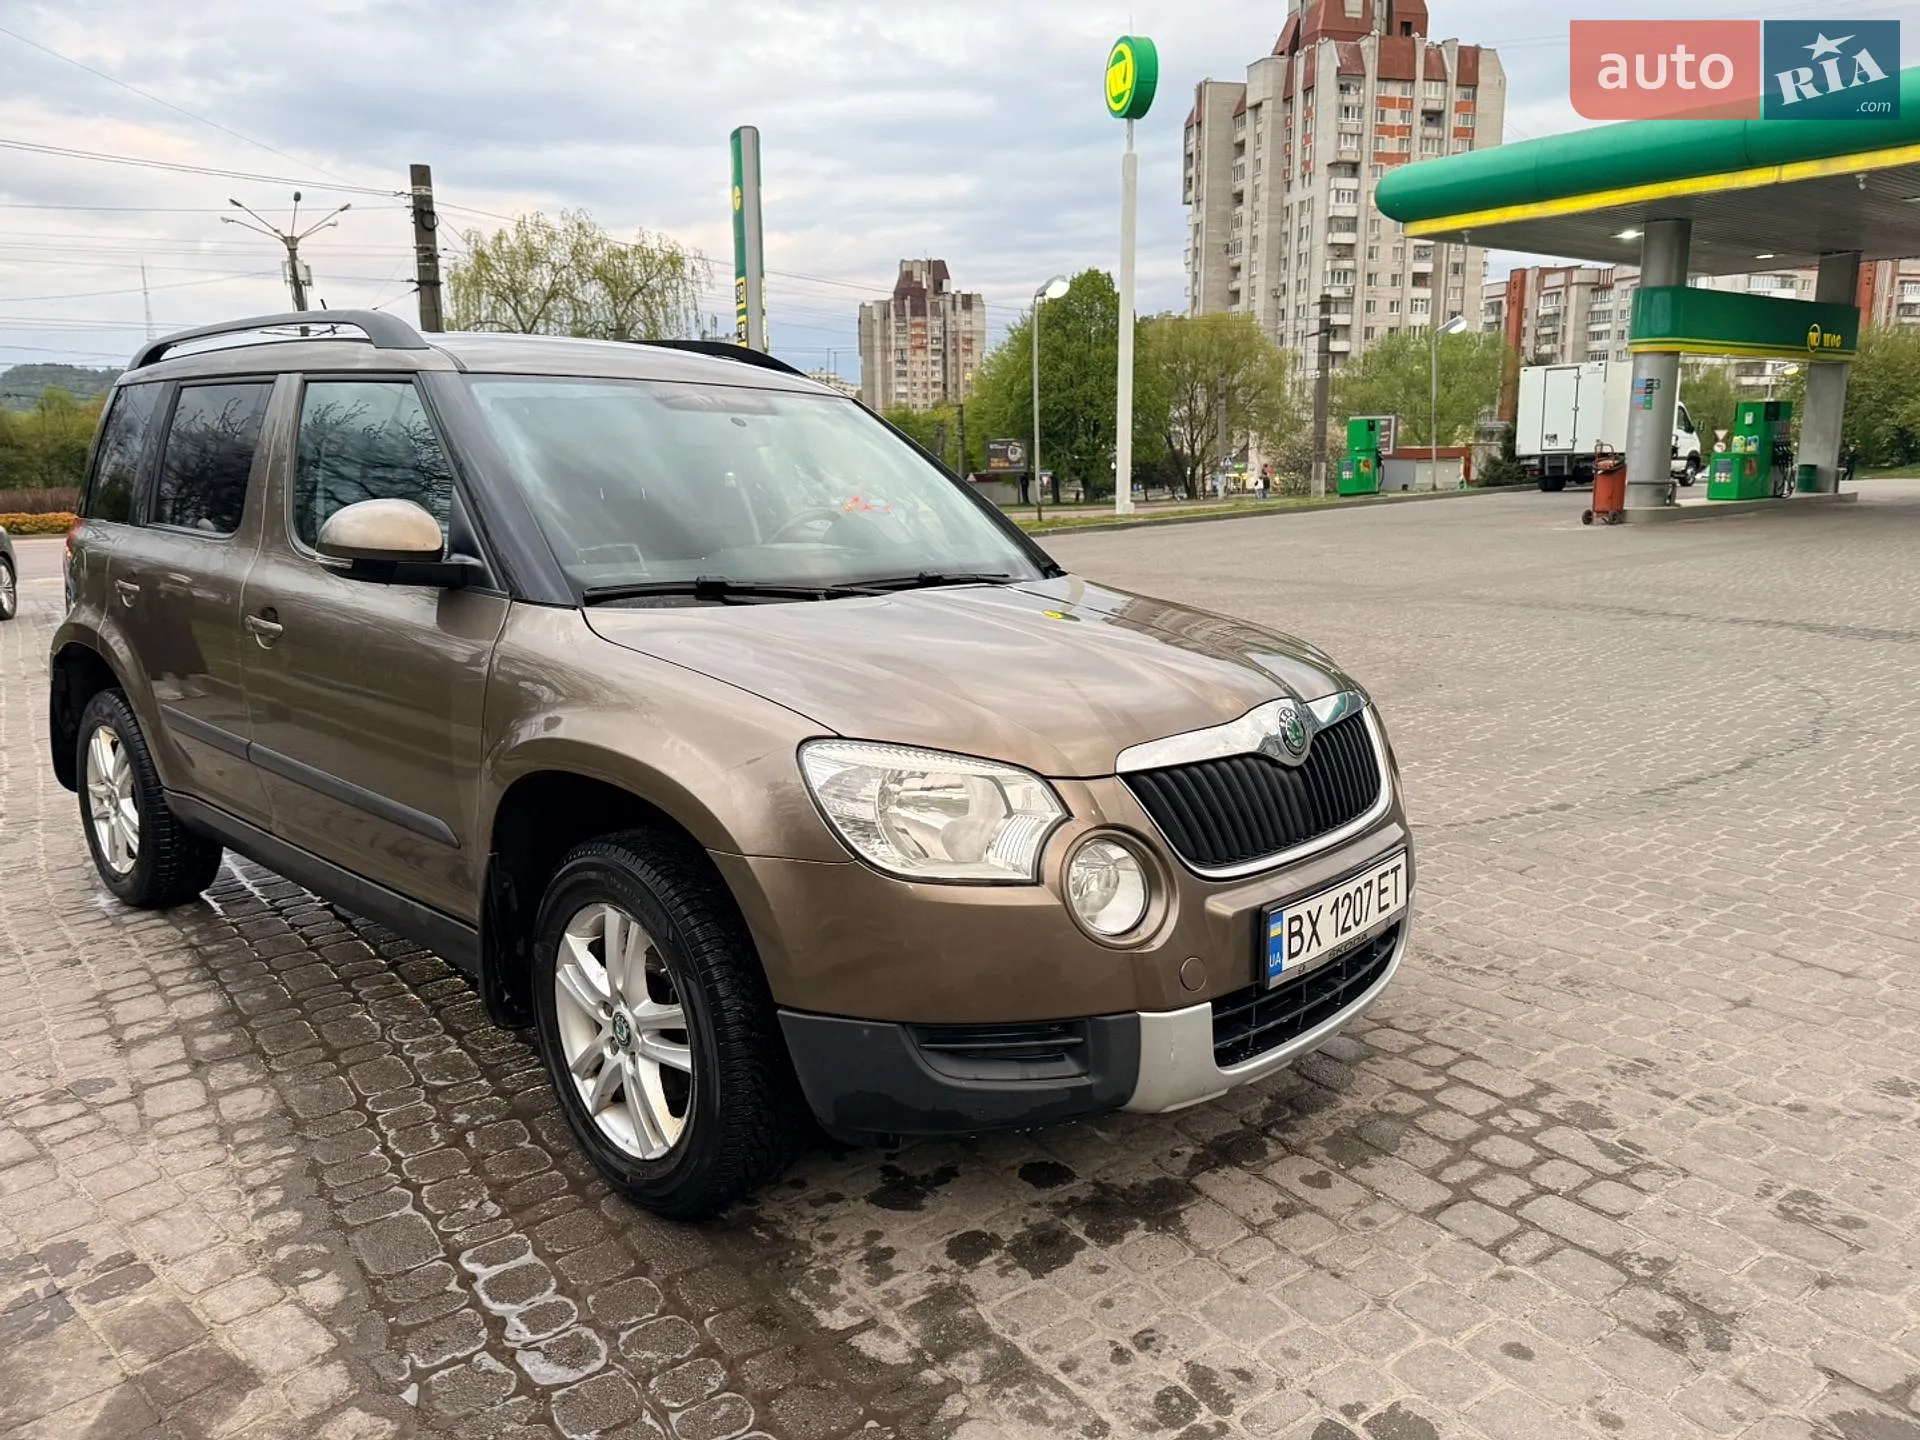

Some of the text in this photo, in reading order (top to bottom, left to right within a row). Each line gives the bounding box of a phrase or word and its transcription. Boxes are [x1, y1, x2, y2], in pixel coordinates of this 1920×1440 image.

[1287, 863, 1402, 960] BX 1207 ET
[1269, 951, 1281, 968] UA
